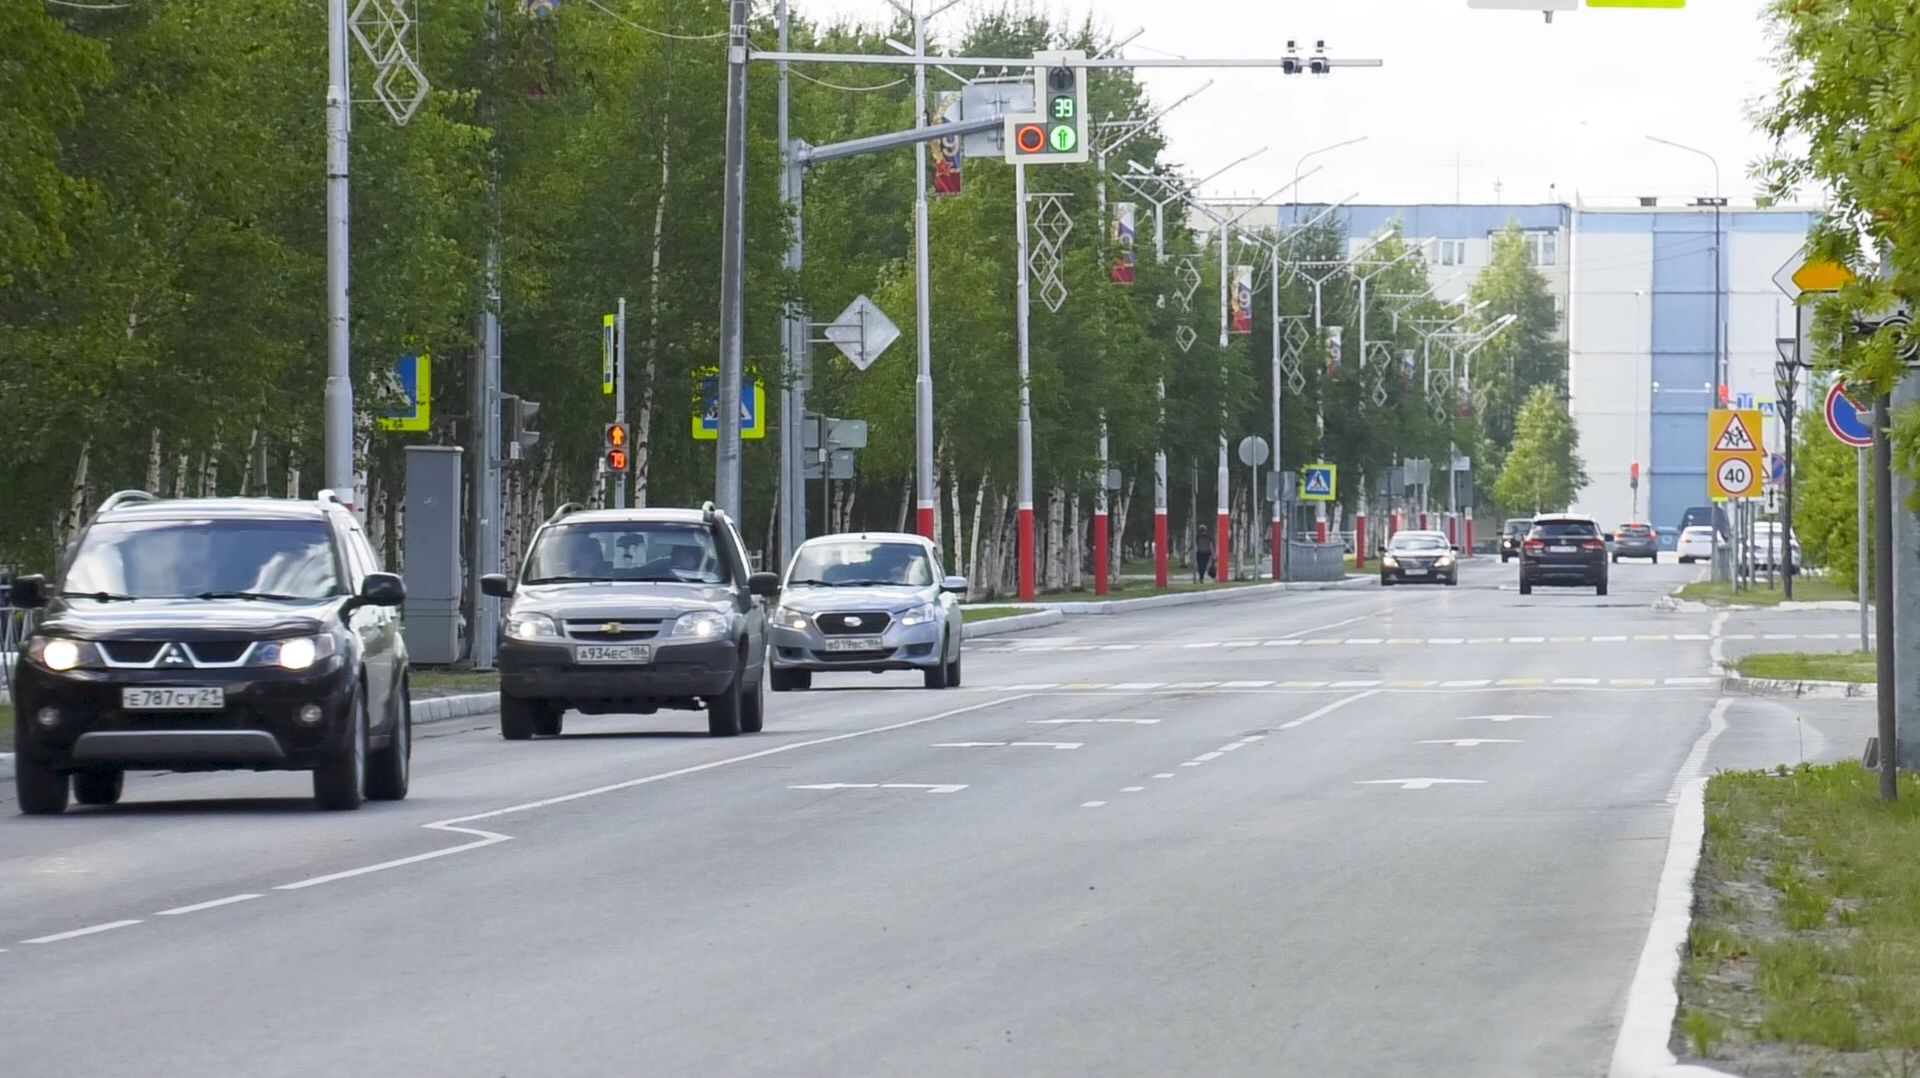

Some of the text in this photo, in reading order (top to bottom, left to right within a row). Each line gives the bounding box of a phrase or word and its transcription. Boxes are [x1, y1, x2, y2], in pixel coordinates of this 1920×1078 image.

[1055, 98, 1073, 117] 39
[1239, 290, 1252, 308] 9
[1724, 468, 1745, 483] 40
[129, 690, 196, 706] Е787СУ
